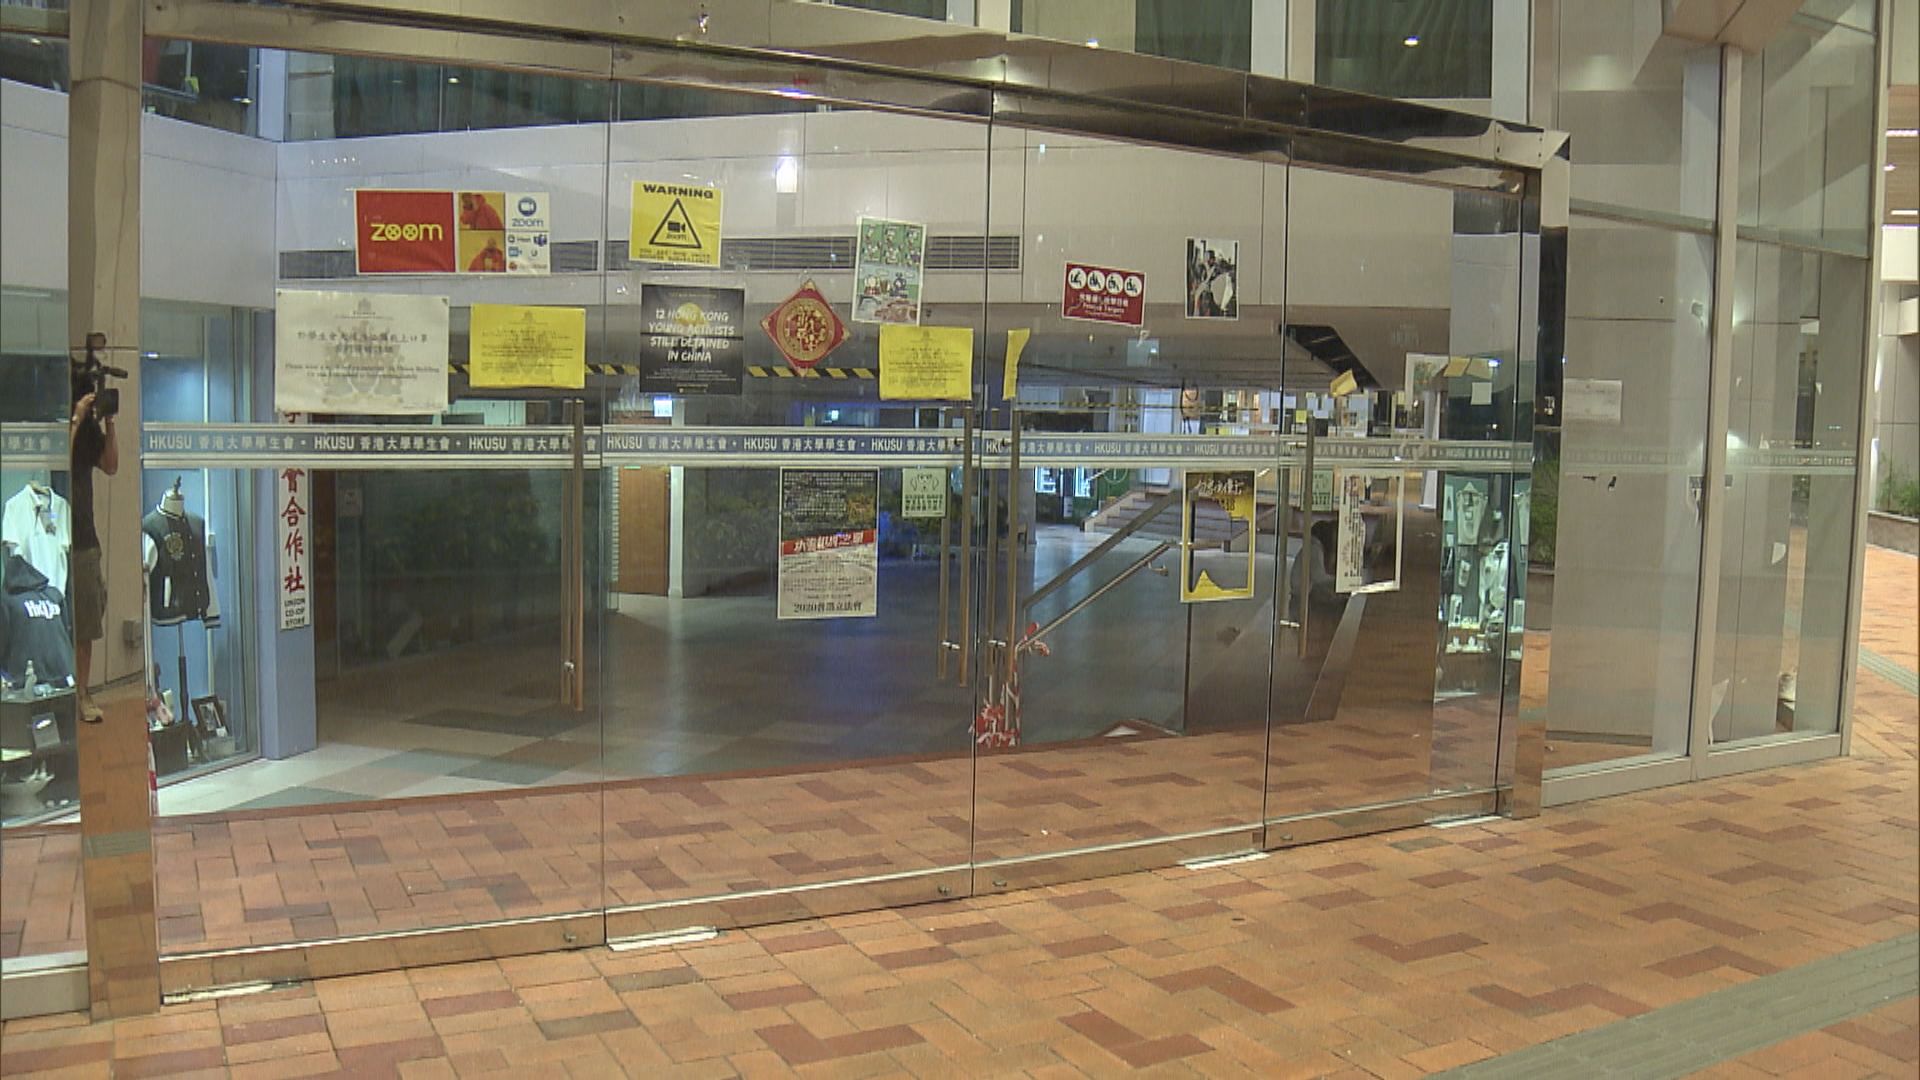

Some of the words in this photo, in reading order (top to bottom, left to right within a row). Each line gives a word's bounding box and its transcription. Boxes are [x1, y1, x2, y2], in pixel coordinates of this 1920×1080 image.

[643, 184, 713, 199] WARNING
[511, 218, 543, 226] zoom
[656, 308, 665, 320] 12
[668, 308, 696, 321] HONG
[700, 310, 729, 322] KONG
[649, 322, 684, 334] YOUNG
[650, 336, 678, 348] STILL
[680, 337, 729, 350] DETAINED
[668, 350, 678, 361] IN
[681, 350, 711, 363] CHINA
[2, 435, 50, 450] 學生會
[149, 434, 192, 449] HKUSU
[199, 435, 294, 450] 香港大學學生會
[314, 436, 354, 450] HKUSU
[360, 436, 450, 450] 香港大學學生會
[469, 437, 507, 450] HKUSU
[607, 436, 642, 450] HKUSU
[744, 437, 777, 451] HKUSU
[871, 438, 903, 452] HKUSU
[1094, 442, 1121, 454] HKUSU
